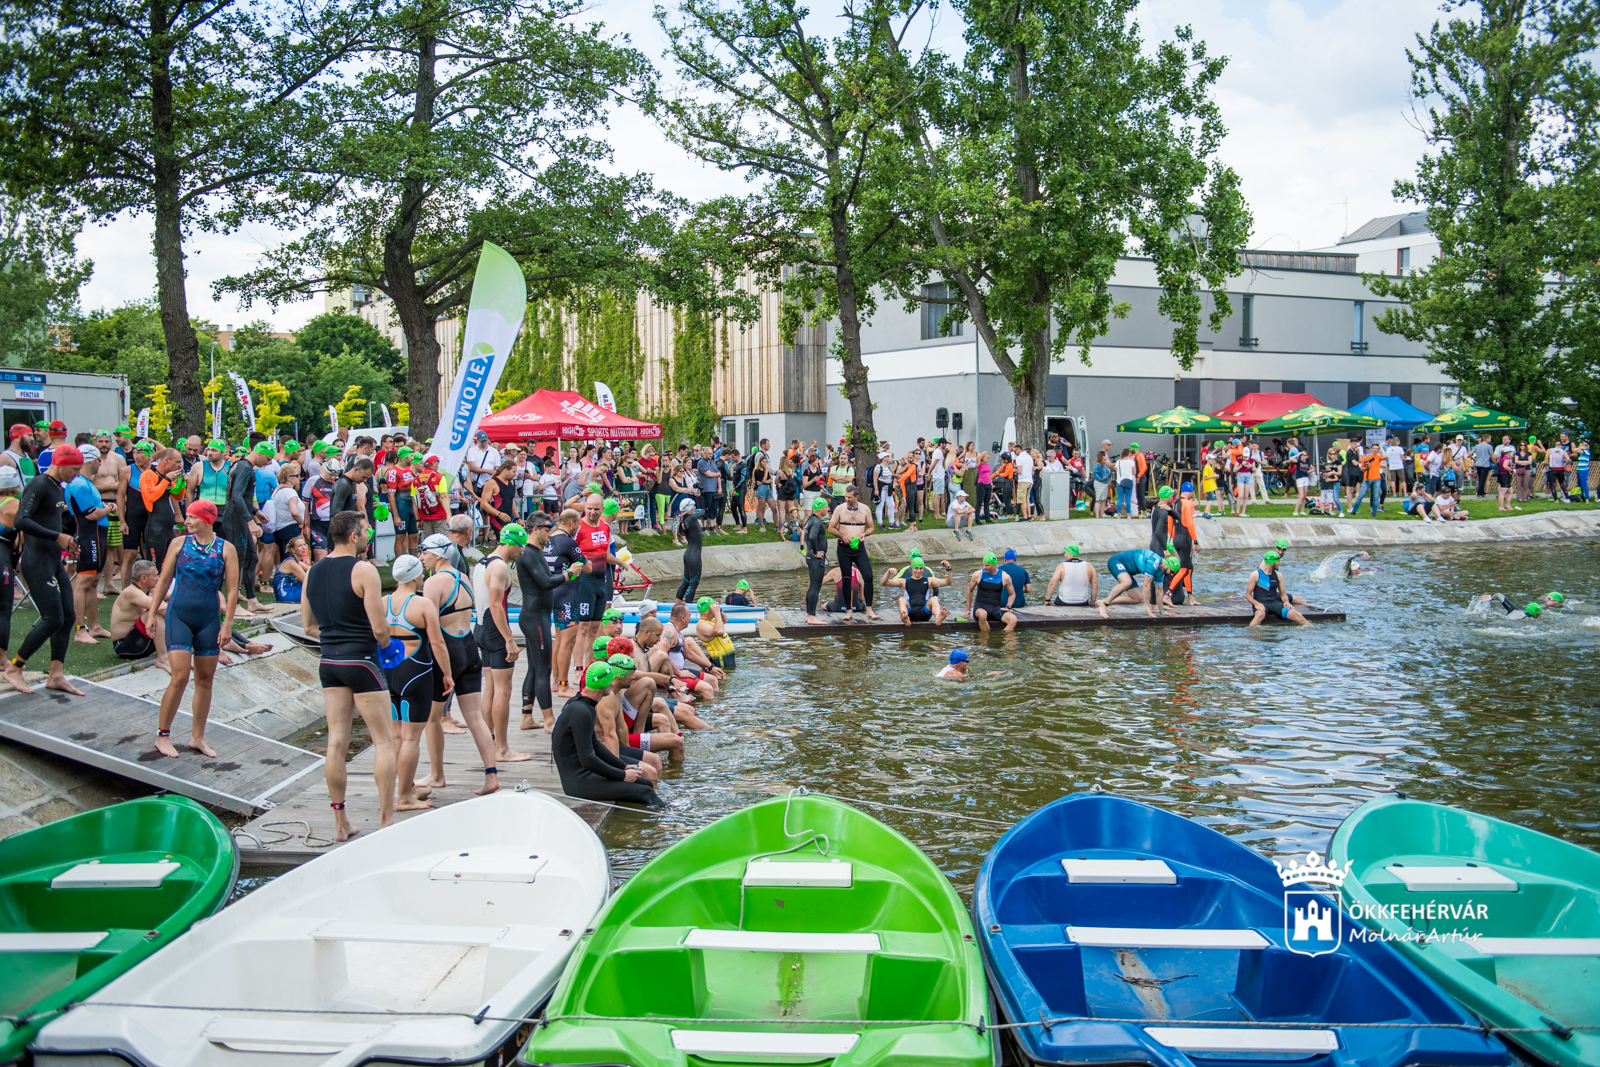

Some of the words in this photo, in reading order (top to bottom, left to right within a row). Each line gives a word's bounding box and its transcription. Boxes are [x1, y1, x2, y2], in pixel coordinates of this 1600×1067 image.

[587, 427, 609, 437] SPORTS
[610, 428, 638, 437] NUTRITION
[591, 530, 607, 543] 575
[580, 602, 590, 616] 575
